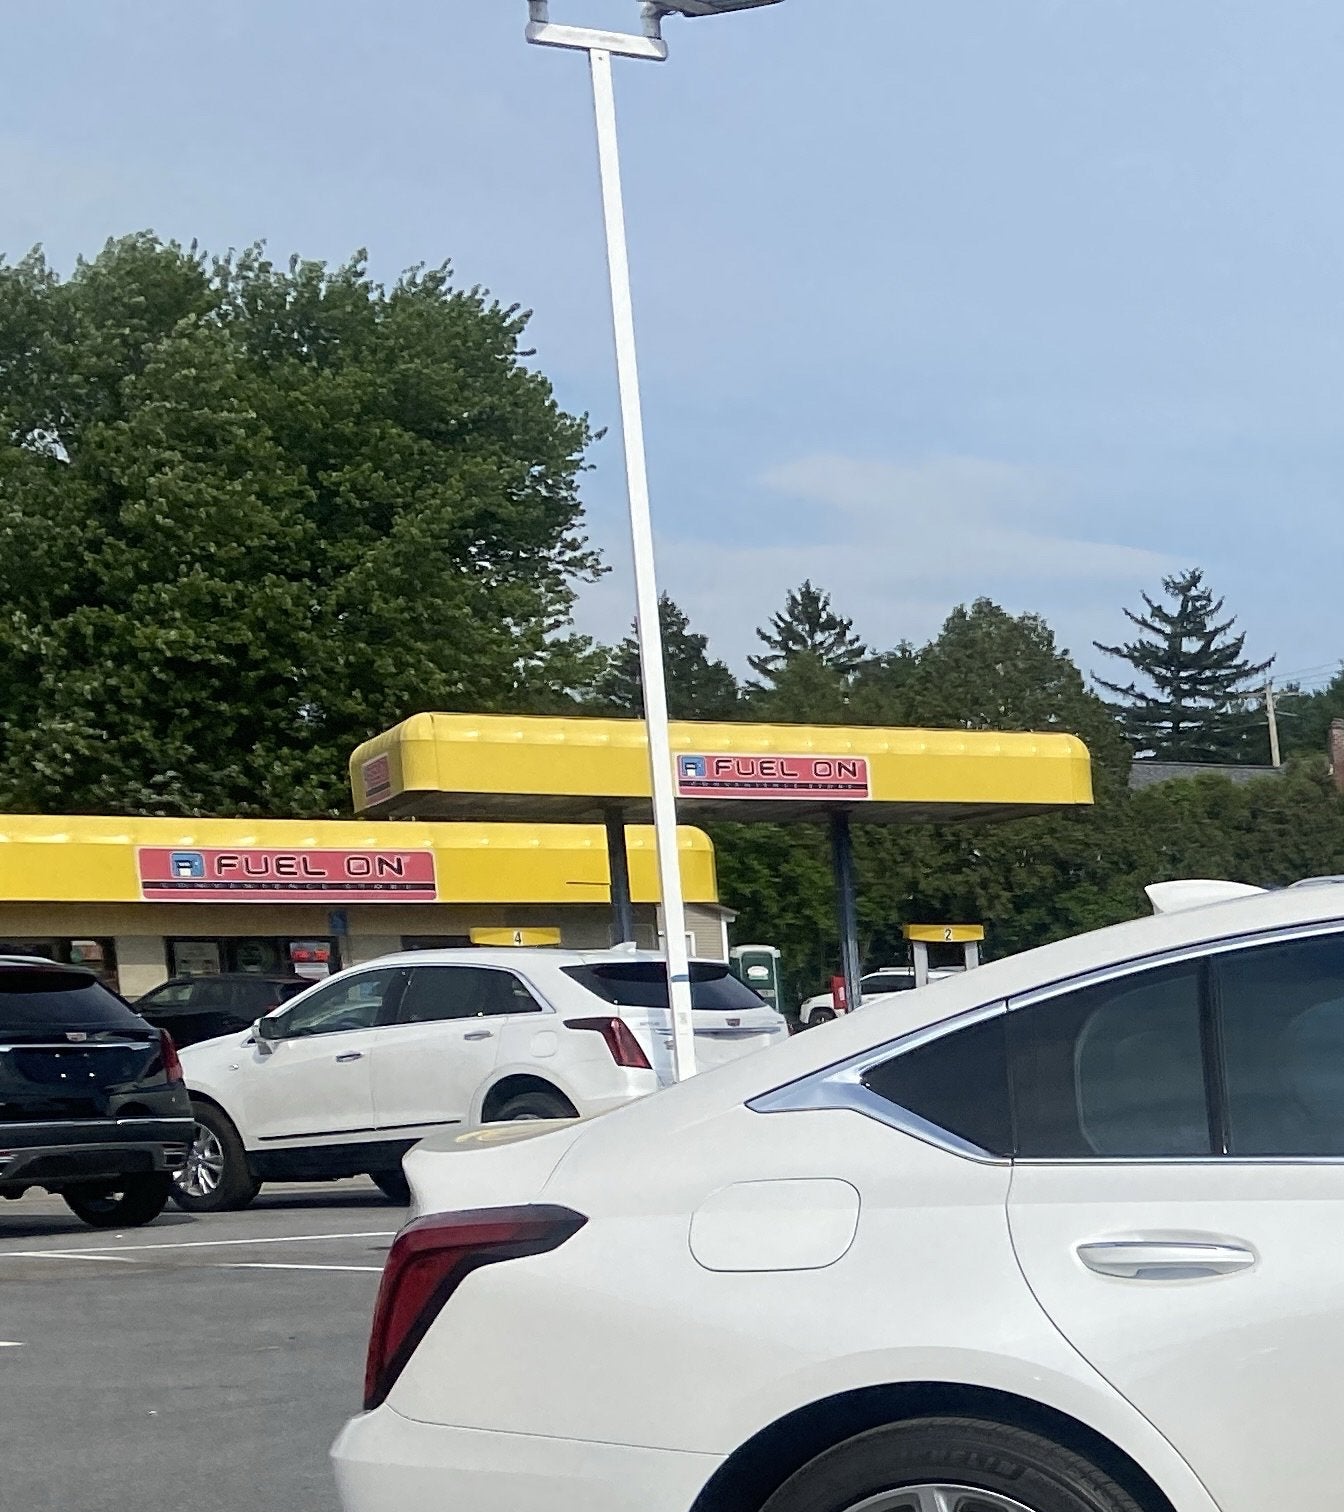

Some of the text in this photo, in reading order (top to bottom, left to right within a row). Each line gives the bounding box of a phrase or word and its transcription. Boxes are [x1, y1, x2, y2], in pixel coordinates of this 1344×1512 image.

[714, 758, 858, 778] FUEL ON
[214, 855, 405, 876] FUEL ON
[513, 929, 523, 946] 4
[944, 927, 953, 941] 2
